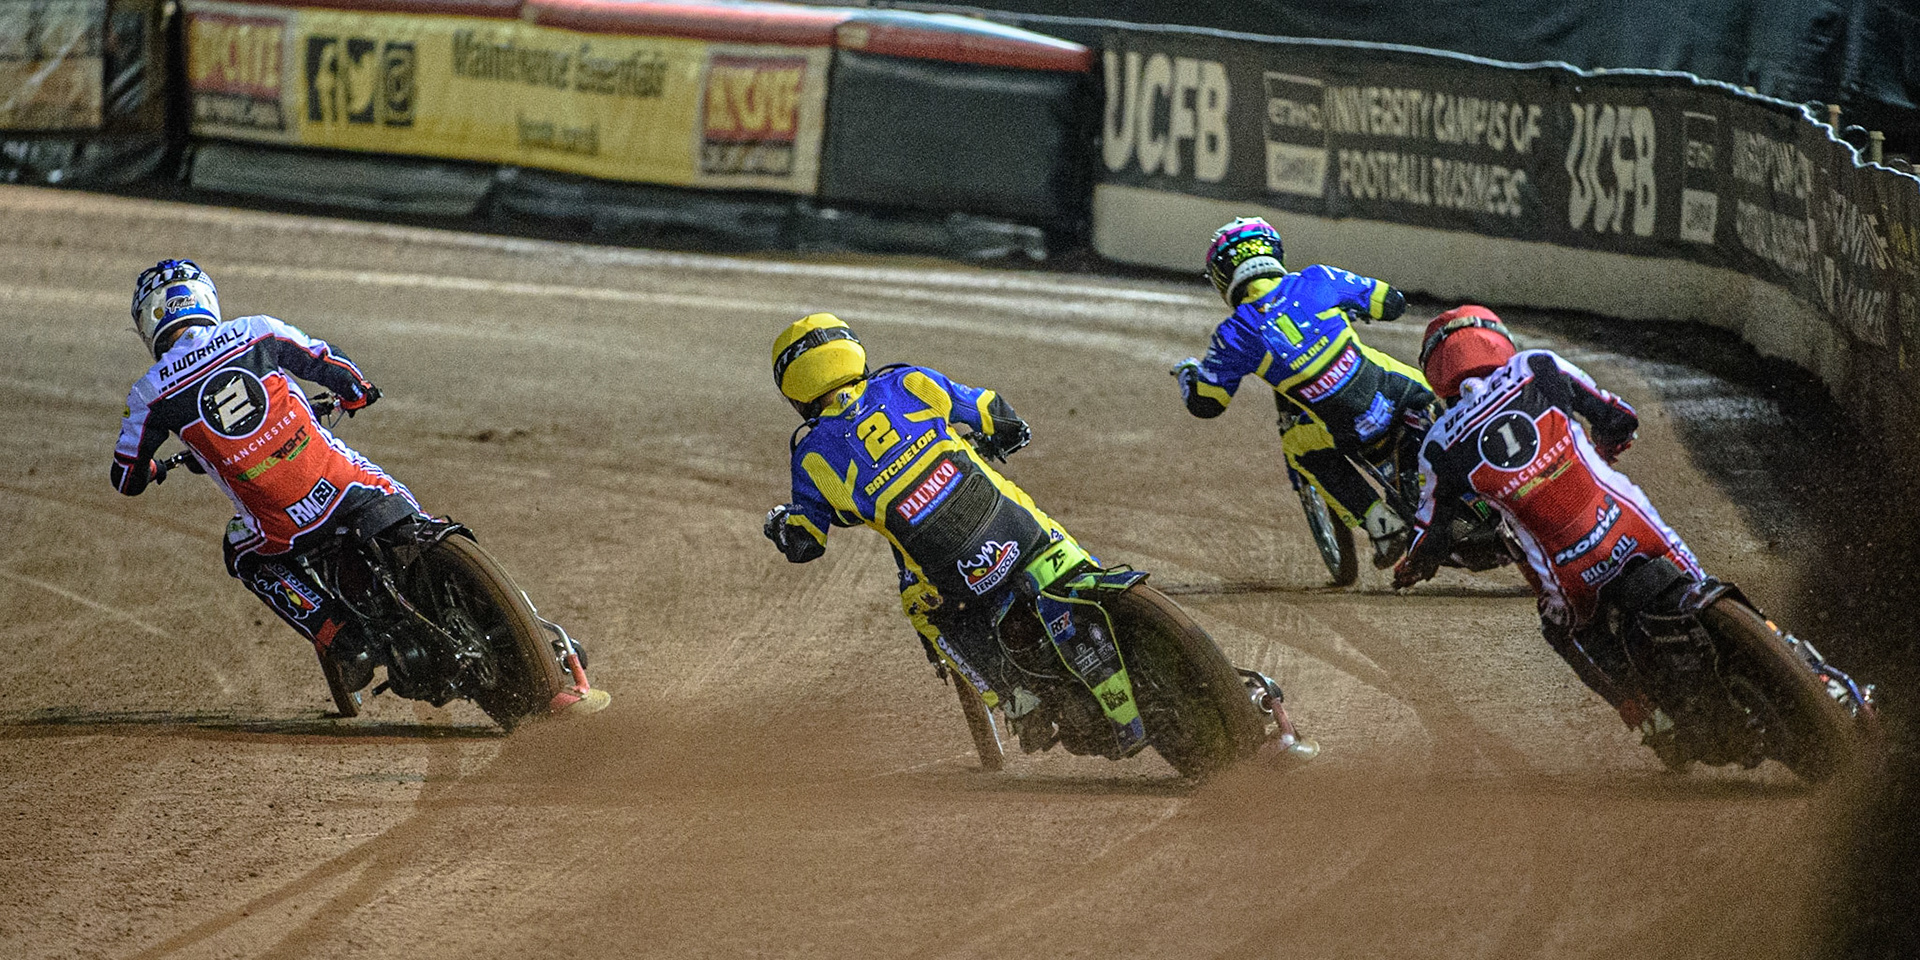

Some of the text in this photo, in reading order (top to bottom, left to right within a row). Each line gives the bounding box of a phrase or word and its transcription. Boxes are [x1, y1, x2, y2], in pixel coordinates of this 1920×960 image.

[1103, 51, 1230, 182] UCFB
[1509, 102, 1542, 153] OF
[1338, 150, 1432, 206] FOOTBALL
[1565, 103, 1656, 237] UCFB
[158, 327, 245, 382] R.WORRALL
[1289, 335, 1330, 371] HOLDER
[1300, 349, 1358, 400] PLUMCO
[214, 376, 257, 431] 2
[222, 410, 298, 467] MANCHESTER
[856, 411, 902, 462] 2
[863, 428, 938, 496] BATCHELOR
[1497, 422, 1521, 458] 1
[899, 462, 956, 519] PLUMCO
[1556, 503, 1621, 565] PLOMYK
